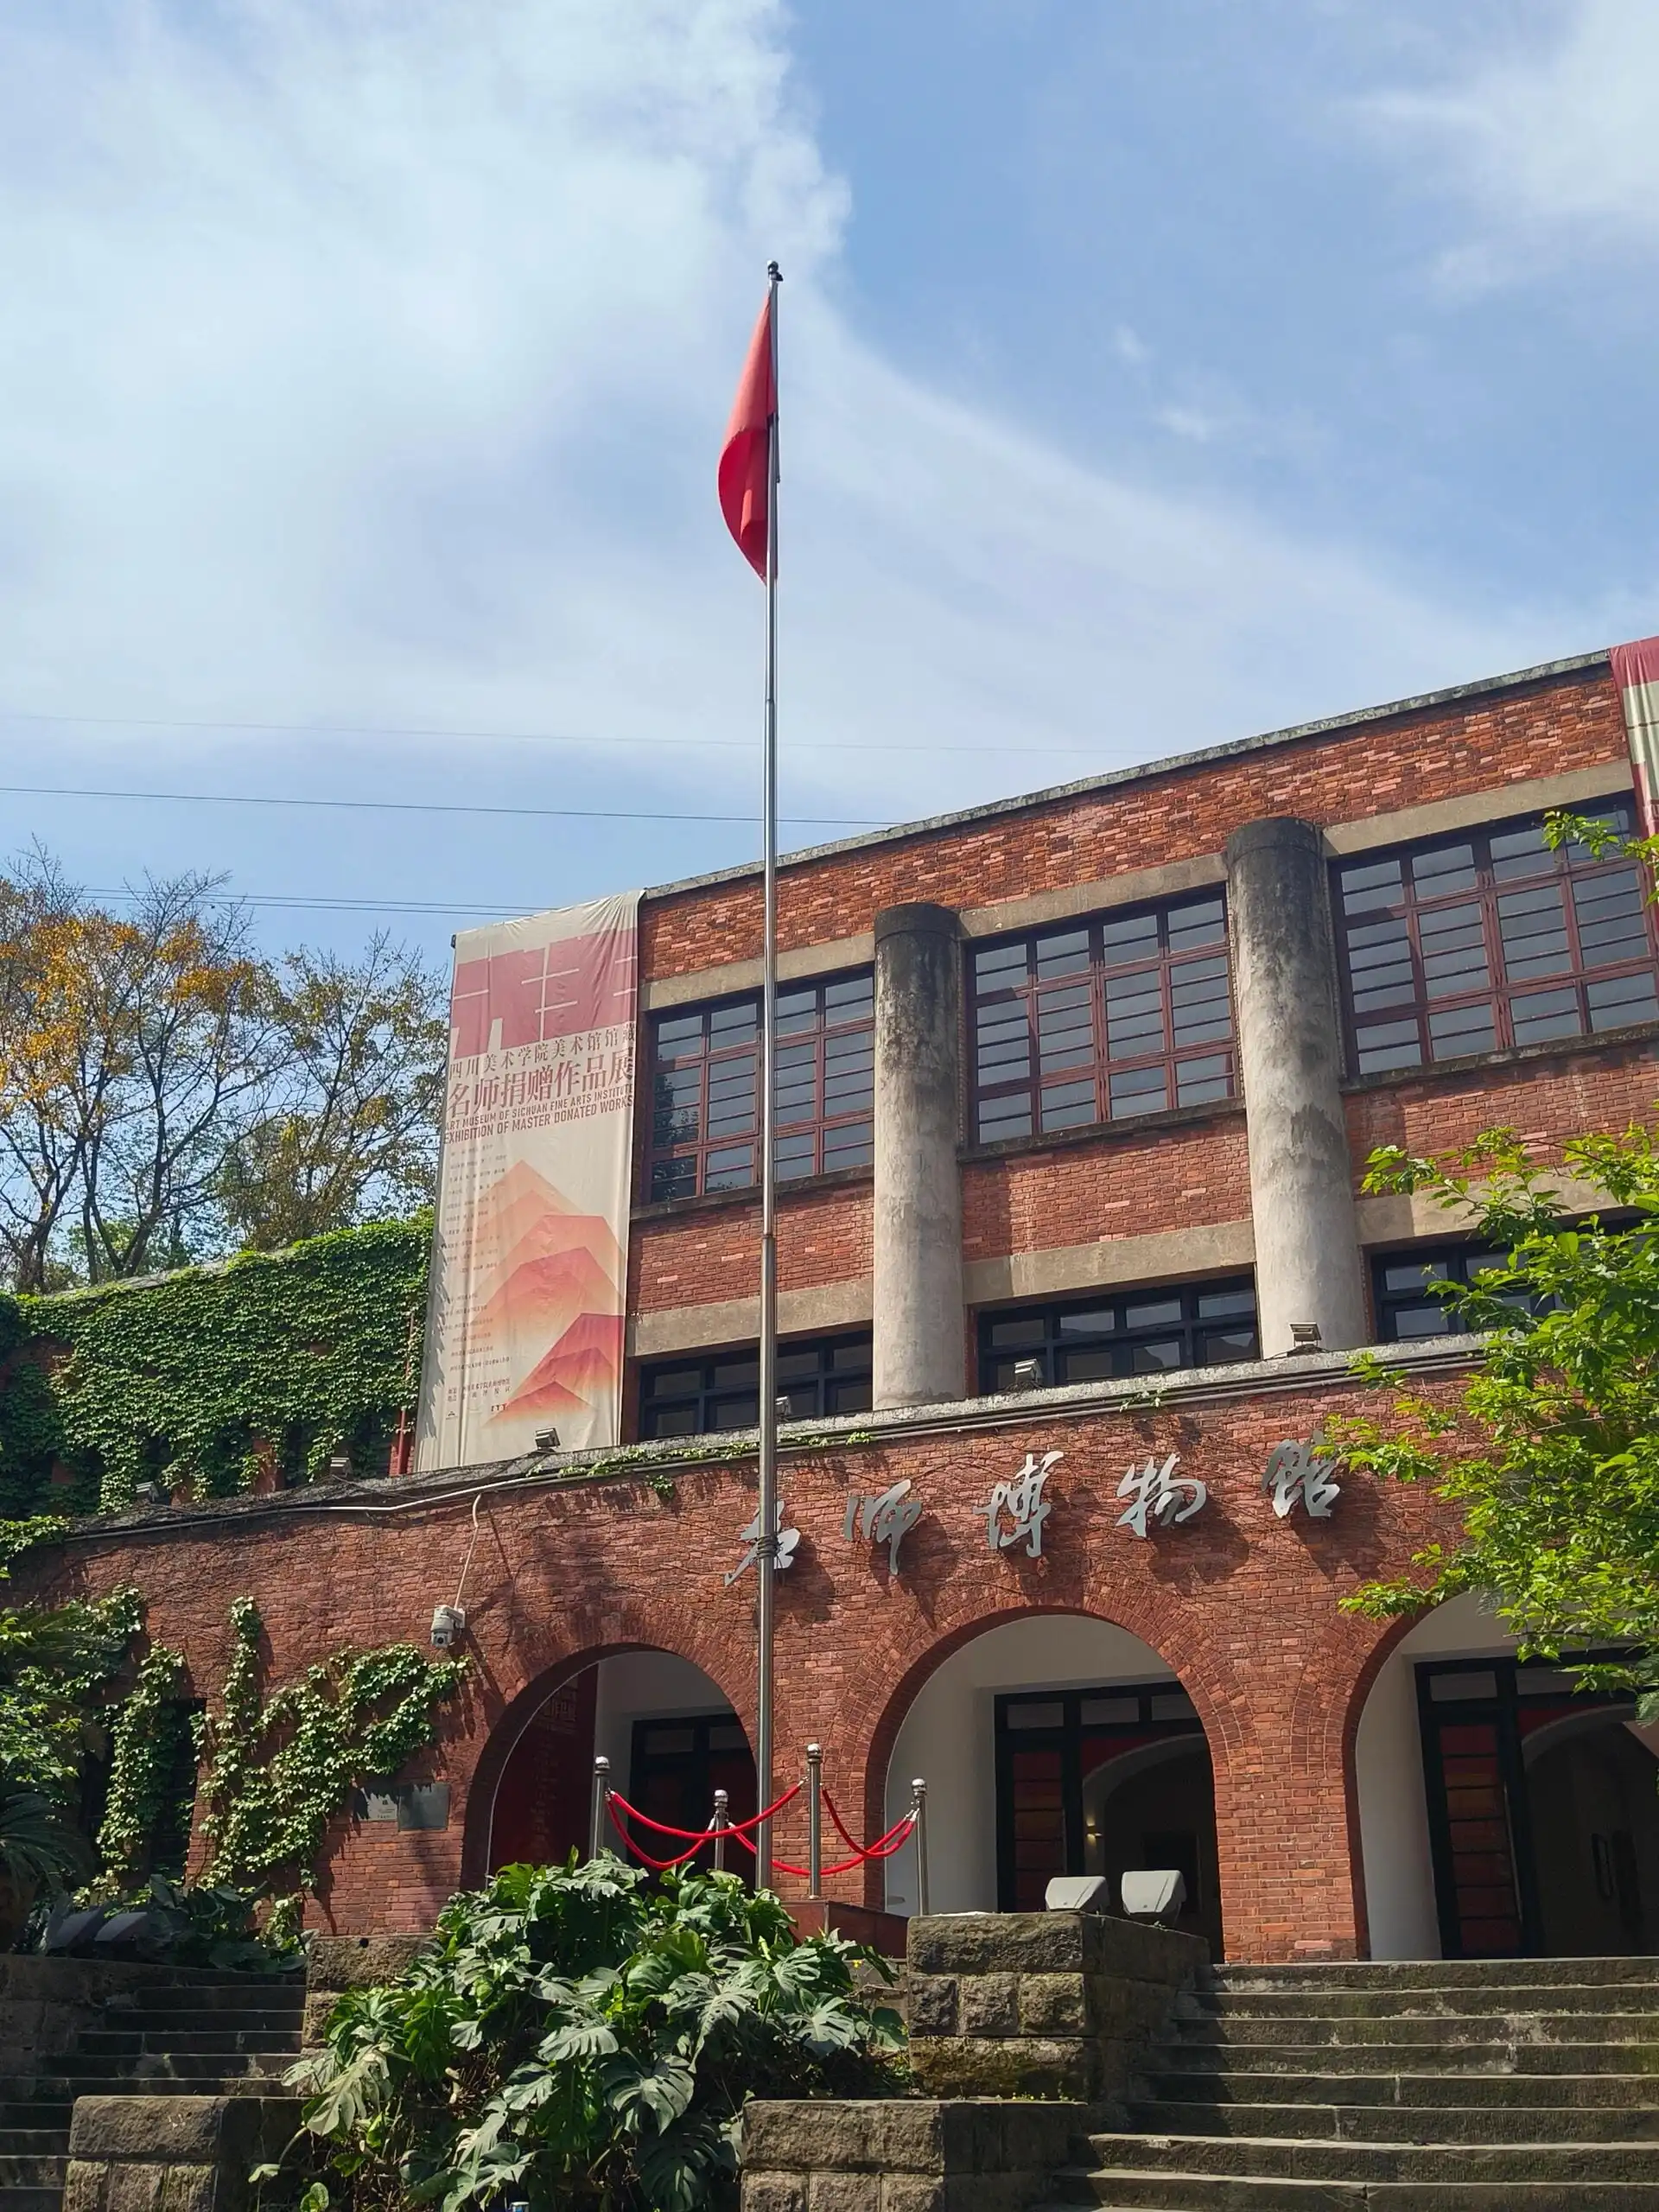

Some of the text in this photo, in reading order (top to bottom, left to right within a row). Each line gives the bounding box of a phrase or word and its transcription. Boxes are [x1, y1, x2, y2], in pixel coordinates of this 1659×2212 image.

[447, 1046, 633, 1118] 名师捐赠作品展
[443, 1095, 633, 1145] EXHIBITION OF MASTER DONATED WORKS
[446, 1120, 460, 1132] ART
[462, 1112, 497, 1128] MUSEUM
[499, 1109, 510, 1122] OF
[512, 1103, 548, 1118] SICHUAN
[550, 1099, 568, 1111] FINE
[570, 1093, 592, 1107] ARTS
